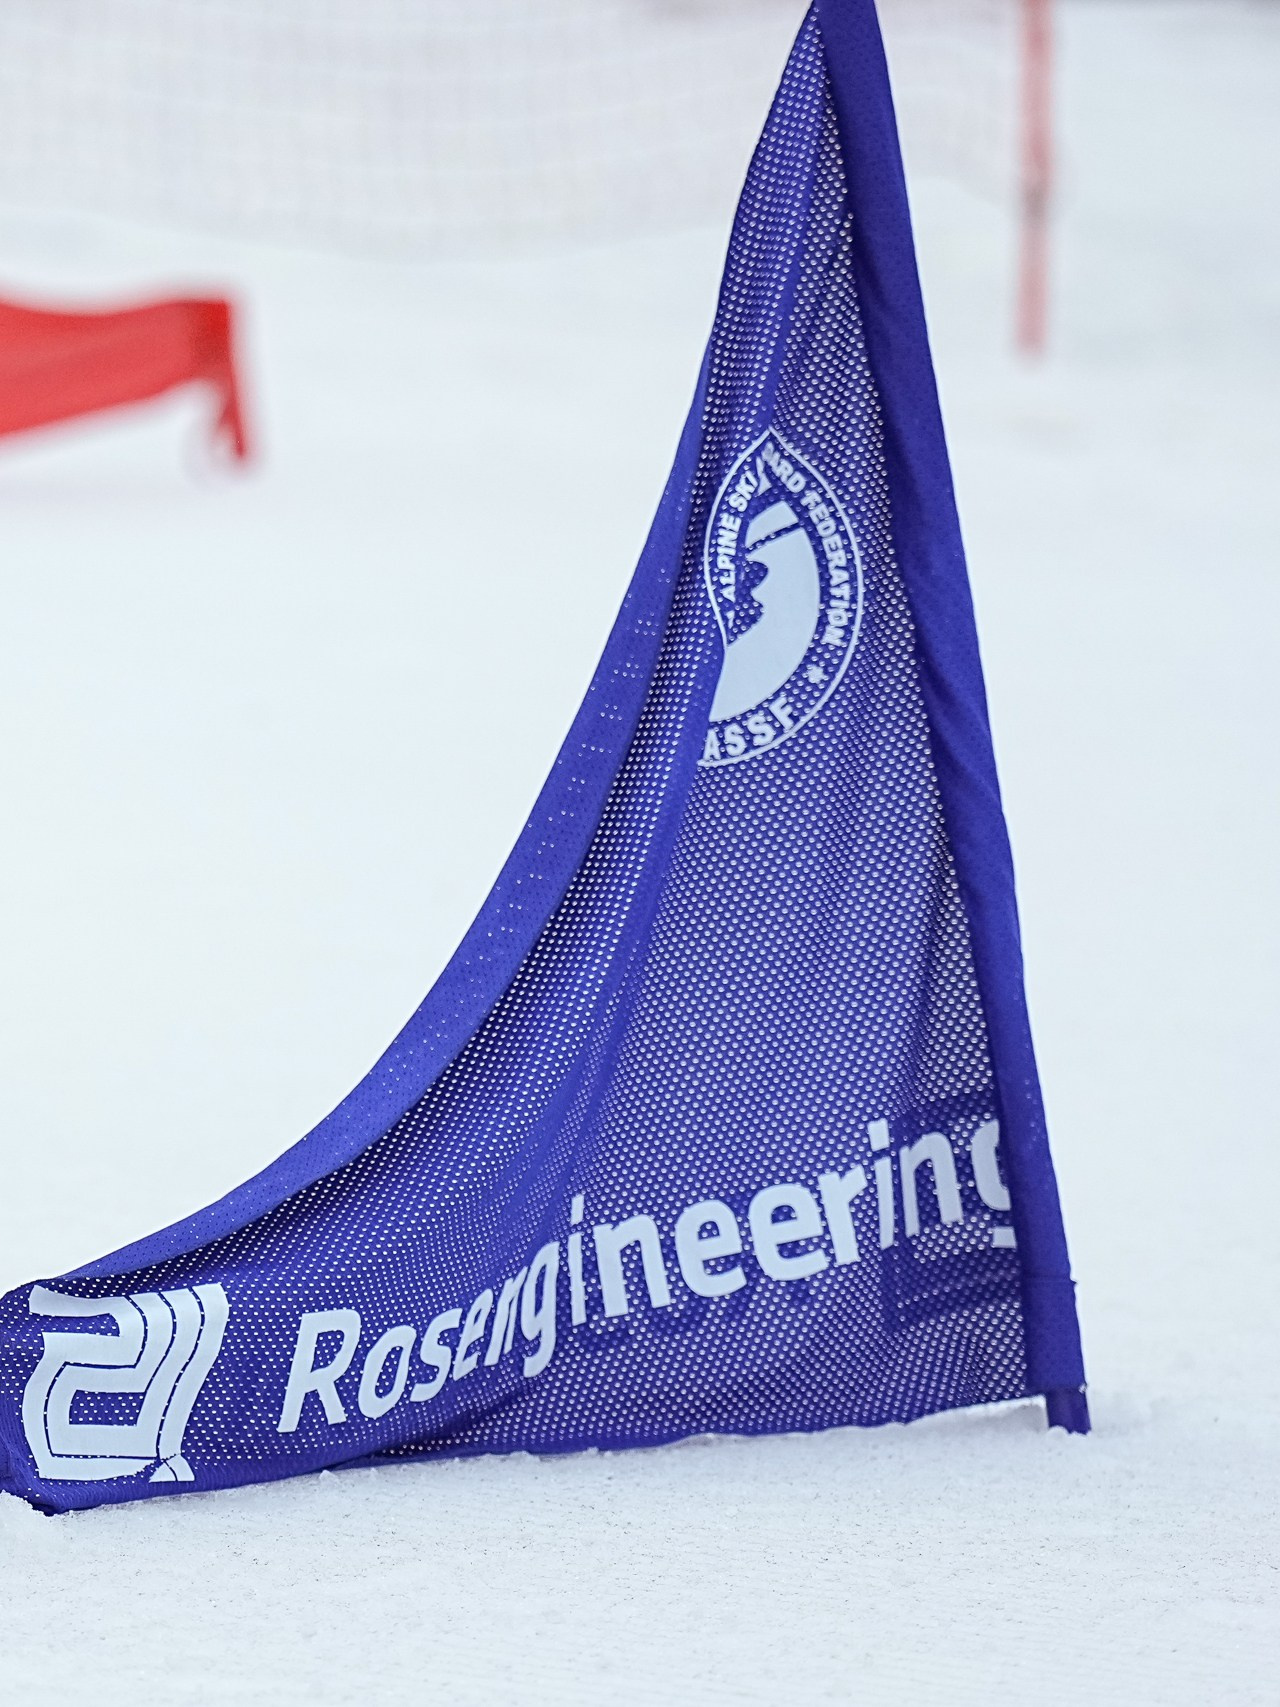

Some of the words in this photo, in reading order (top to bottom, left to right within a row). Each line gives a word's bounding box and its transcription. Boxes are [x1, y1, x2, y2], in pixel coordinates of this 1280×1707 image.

[728, 470, 758, 512] SKI
[717, 515, 741, 602] ALPINE
[800, 489, 852, 646] FEDERATION
